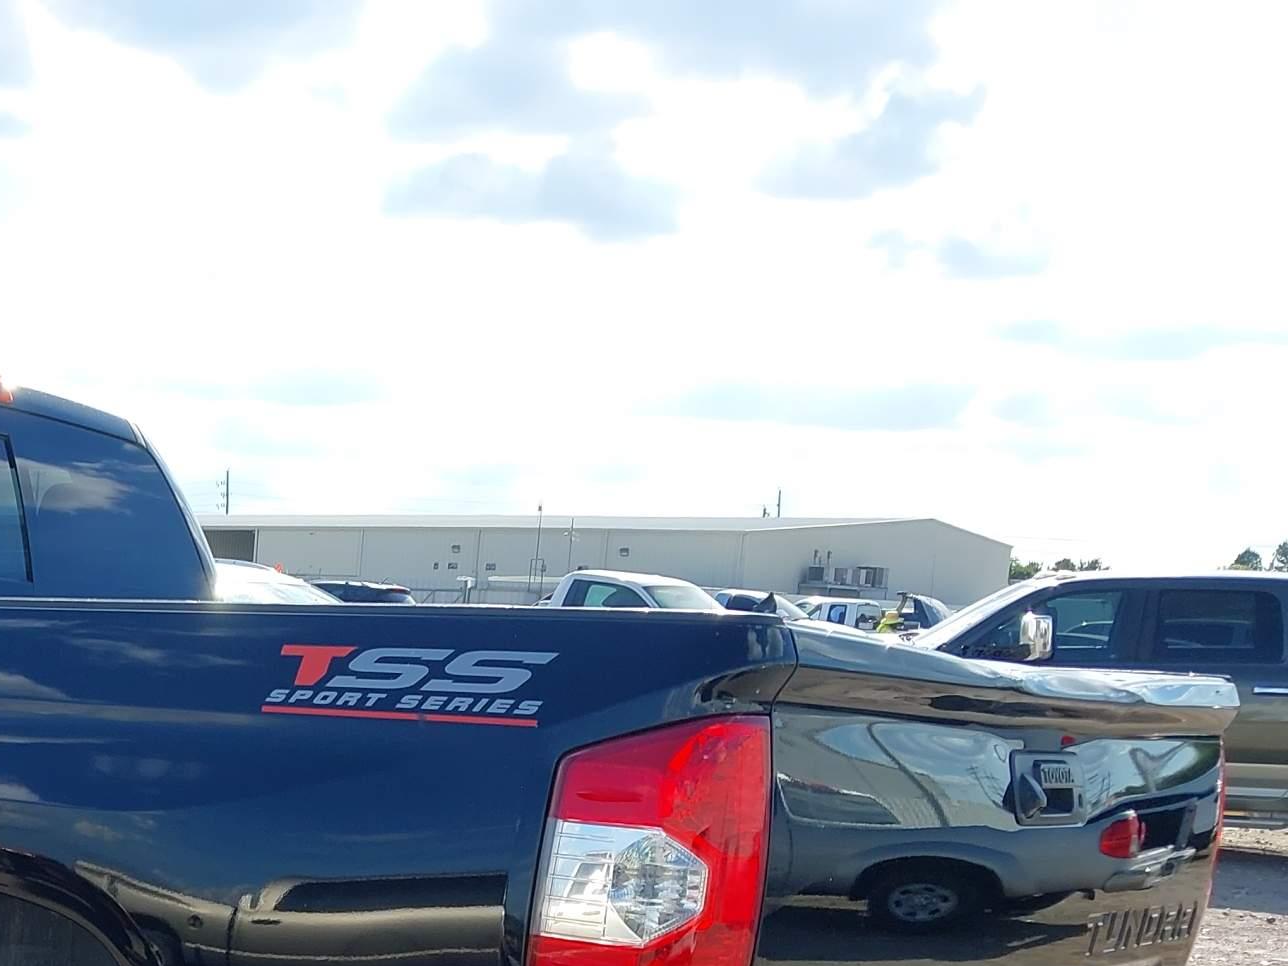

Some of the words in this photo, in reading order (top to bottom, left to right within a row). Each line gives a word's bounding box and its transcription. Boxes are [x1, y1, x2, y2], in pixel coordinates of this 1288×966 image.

[280, 644, 560, 694] TSS
[264, 688, 388, 708] SPORT
[395, 694, 544, 716] SERIES
[1083, 900, 1199, 957] TUNDRA
